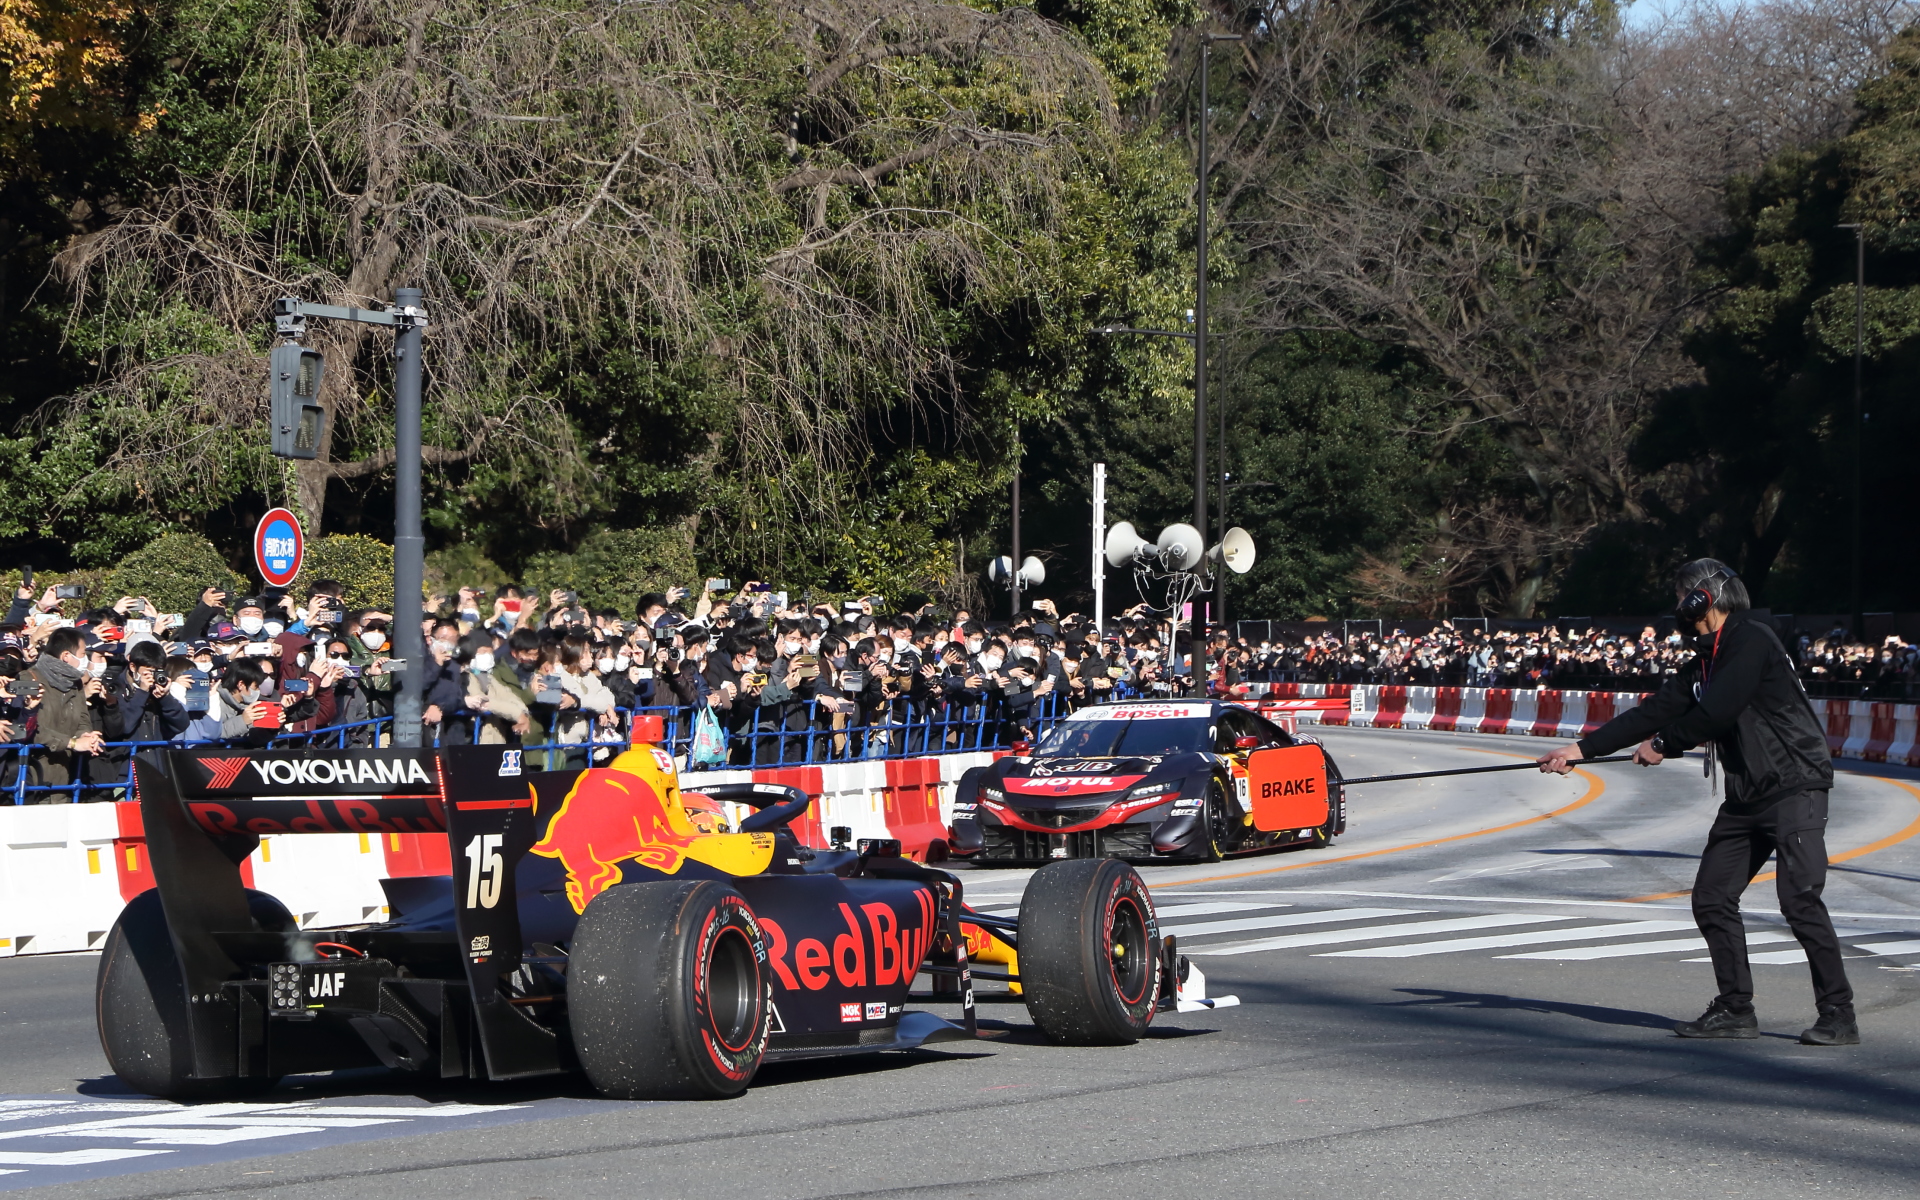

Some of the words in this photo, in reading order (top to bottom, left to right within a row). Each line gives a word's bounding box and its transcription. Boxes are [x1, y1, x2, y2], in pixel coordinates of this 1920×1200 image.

[265, 538, 295, 557] 消防水利
[1112, 709, 1189, 719] BOSCH
[251, 759, 431, 785] YOKOHAMA
[1022, 777, 1114, 787] MOTUL
[1239, 780, 1246, 797] 16
[1262, 778, 1315, 798] BRAKE
[1128, 796, 1162, 808] DUNLOP
[465, 834, 503, 909] 15
[758, 903, 867, 990] Red
[860, 888, 934, 985] Bull
[1145, 919, 1158, 940] FR
[753, 940, 766, 964] RR
[309, 972, 345, 998] JAF
[1147, 957, 1160, 1012] ADVAN
[758, 982, 772, 1054] ADVAN
[842, 1005, 860, 1017] NGK
